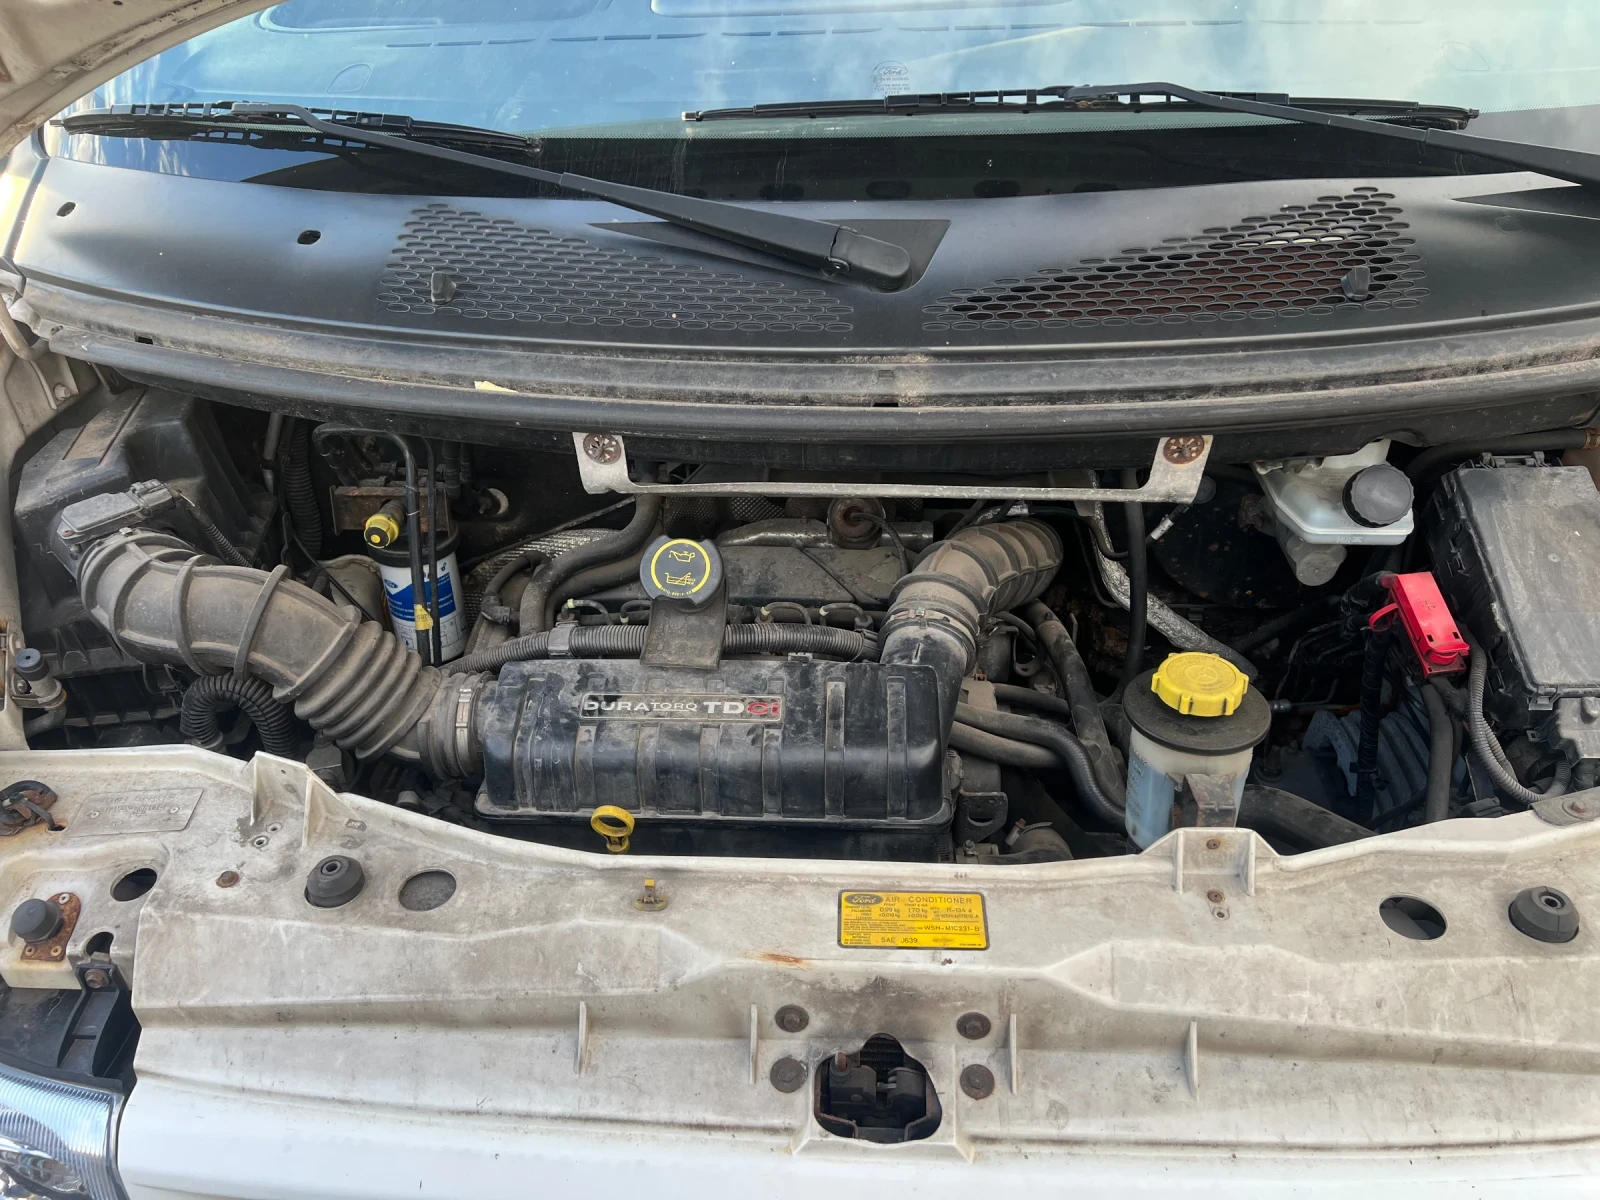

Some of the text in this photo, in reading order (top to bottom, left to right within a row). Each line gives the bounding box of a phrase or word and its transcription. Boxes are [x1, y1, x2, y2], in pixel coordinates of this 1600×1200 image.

[883, 67, 902, 75] Ford
[703, 701, 780, 716] TDCi
[851, 895, 878, 904] Ford
[908, 896, 972, 904] CONDITIONER
